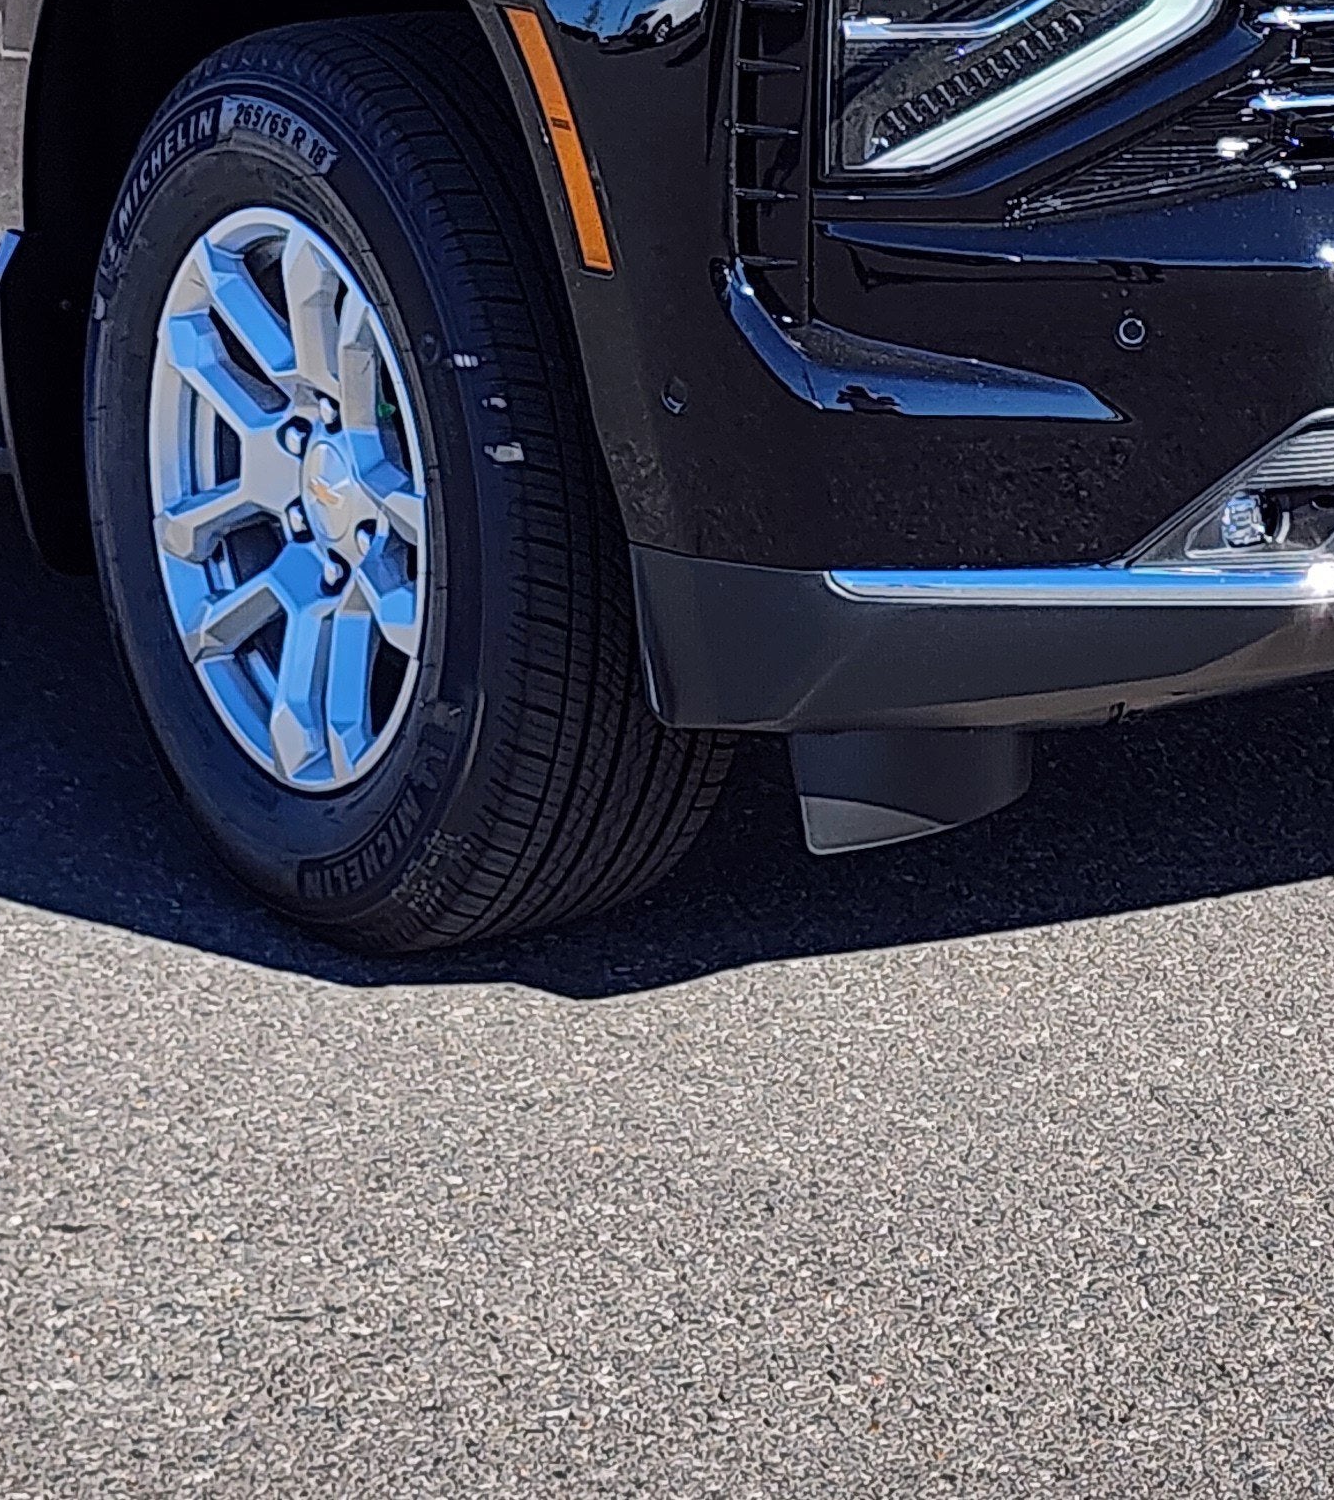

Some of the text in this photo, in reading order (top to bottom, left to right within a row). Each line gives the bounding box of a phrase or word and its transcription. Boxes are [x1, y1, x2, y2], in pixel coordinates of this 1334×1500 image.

[118, 102, 328, 237] MICHELIN 265/65 R 18
